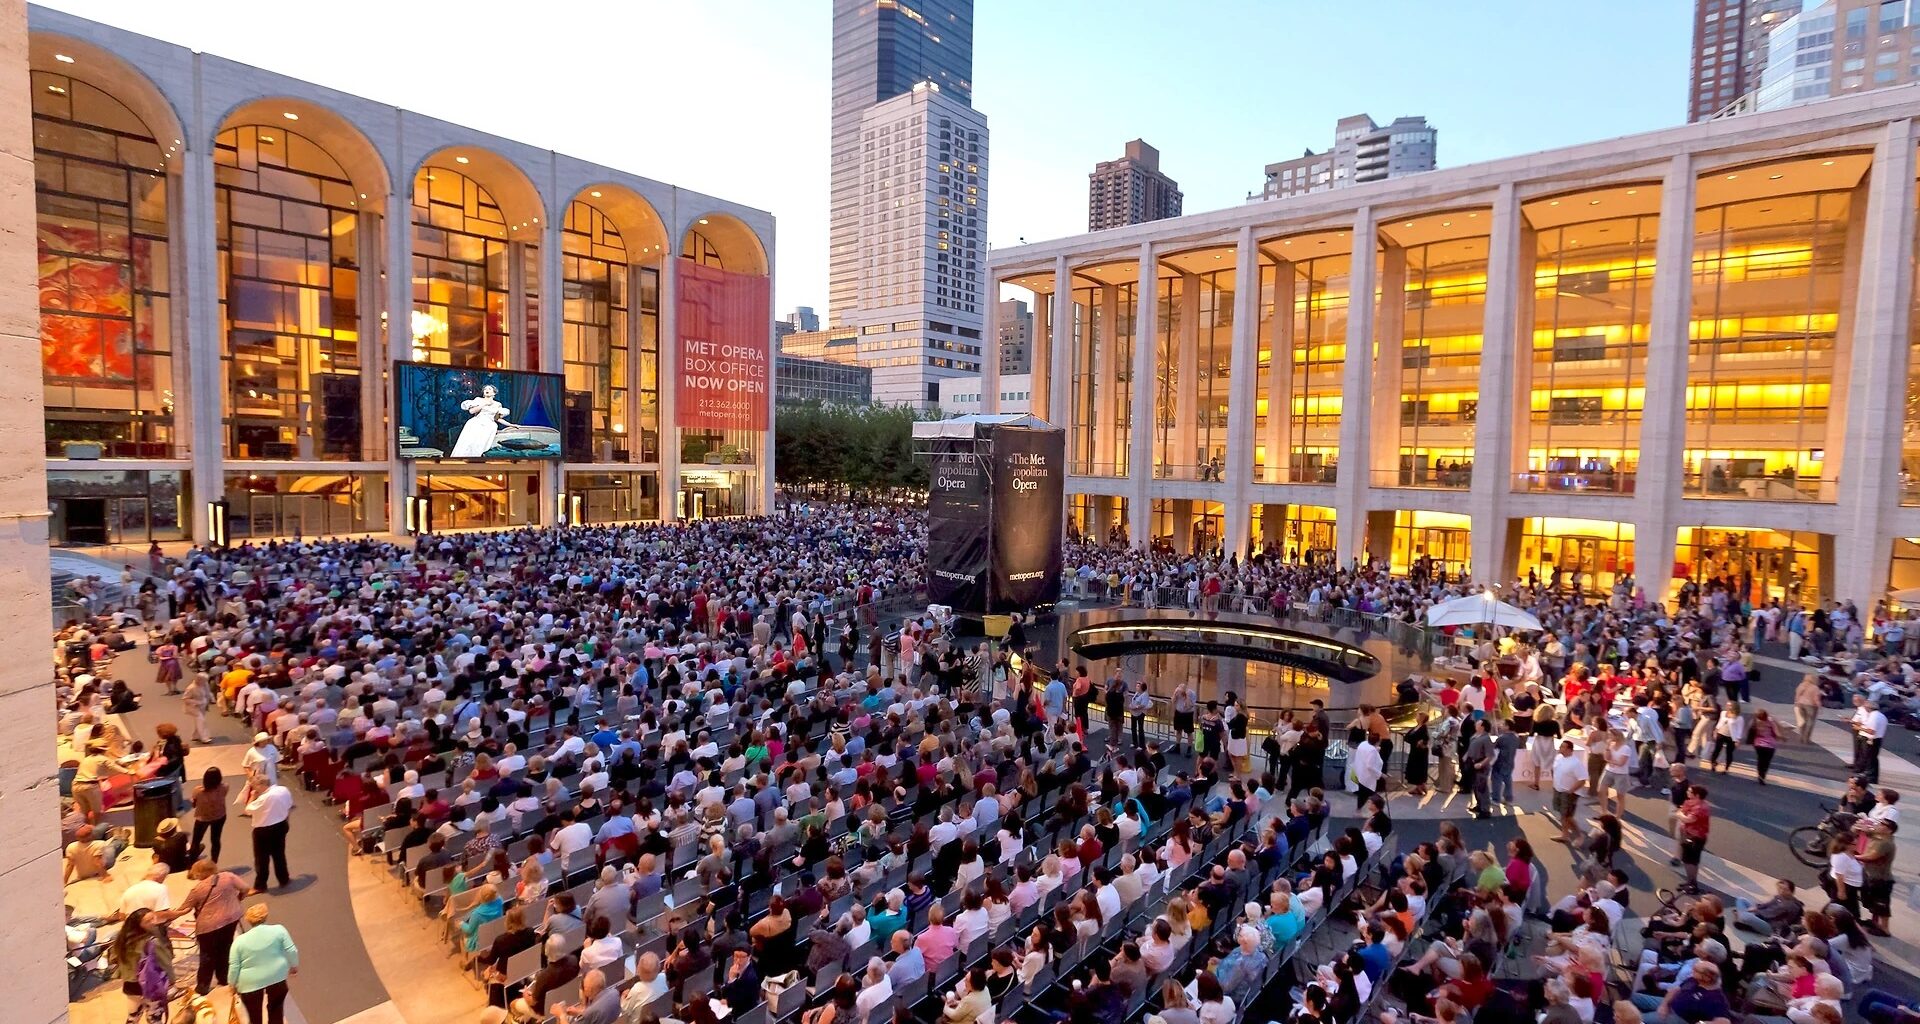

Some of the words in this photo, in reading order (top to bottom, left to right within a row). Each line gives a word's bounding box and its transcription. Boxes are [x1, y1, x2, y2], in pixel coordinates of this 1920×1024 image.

[686, 340, 717, 355] MET
[721, 345, 764, 361] OPERA
[685, 358, 716, 373] BOX
[719, 362, 764, 378] OFFICE
[685, 375, 724, 390] NOW
[727, 380, 764, 393] OPEN
[699, 399, 750, 410] 212.362.6000
[699, 411, 750, 421] metopera.org
[1012, 453, 1029, 464] The
[1029, 454, 1045, 465] Met
[939, 464, 979, 478] ropolitan
[1013, 466, 1048, 480] ropolitan
[938, 476, 966, 491] Opera
[1012, 478, 1038, 493] Opera
[935, 569, 976, 584] metopera.org
[1009, 570, 1044, 581] metopera.org
